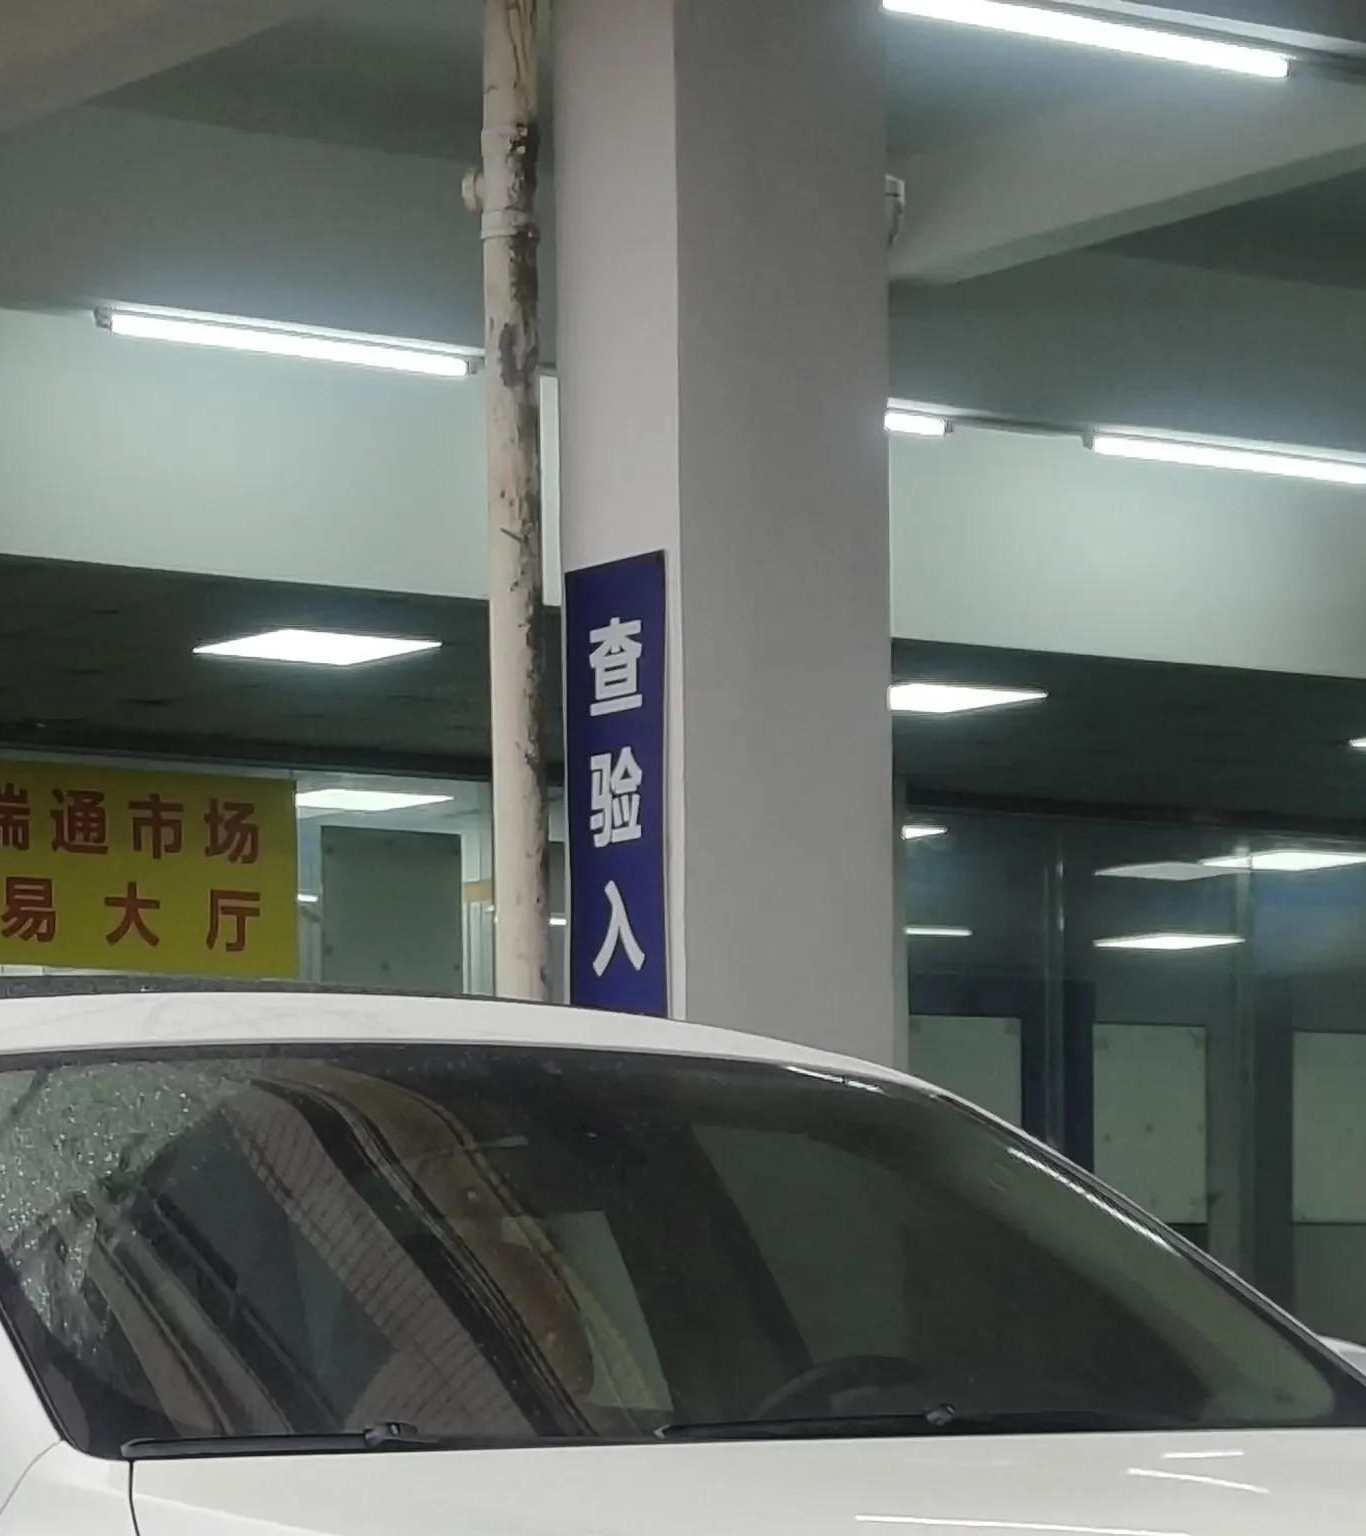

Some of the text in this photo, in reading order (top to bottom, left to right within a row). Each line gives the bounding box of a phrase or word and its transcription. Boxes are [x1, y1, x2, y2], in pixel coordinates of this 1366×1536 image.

[588, 616, 646, 978] 查验入
[0, 876, 261, 953] 易大厅
